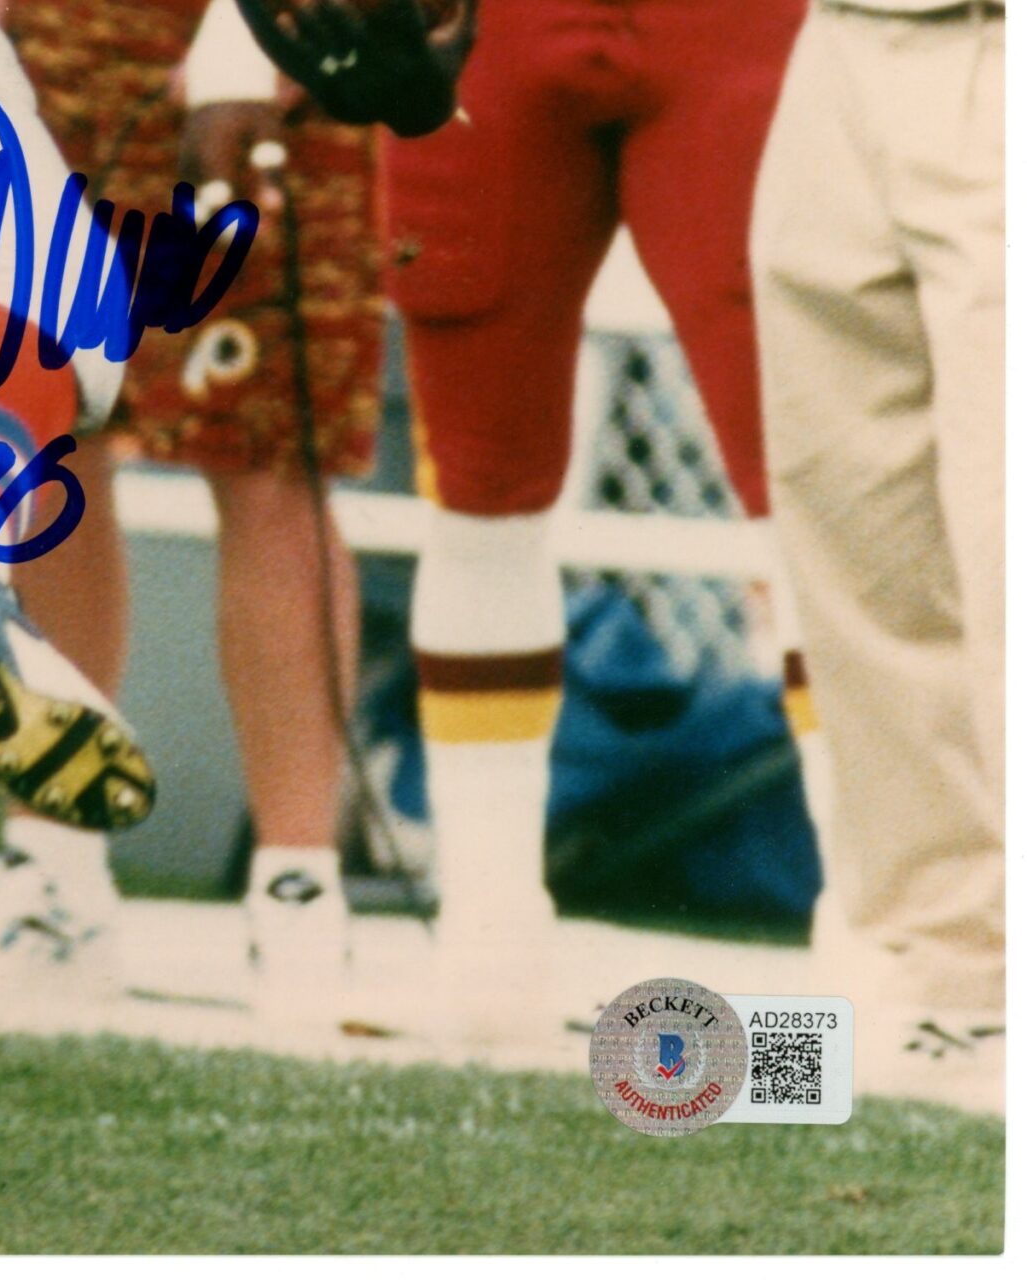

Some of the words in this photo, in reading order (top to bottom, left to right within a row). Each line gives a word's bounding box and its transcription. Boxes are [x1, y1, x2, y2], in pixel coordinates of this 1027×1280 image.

[623, 996, 719, 1029] BECKETT
[748, 1011, 838, 1030] AD28373
[614, 1080, 722, 1121] AUTHENTICATED
